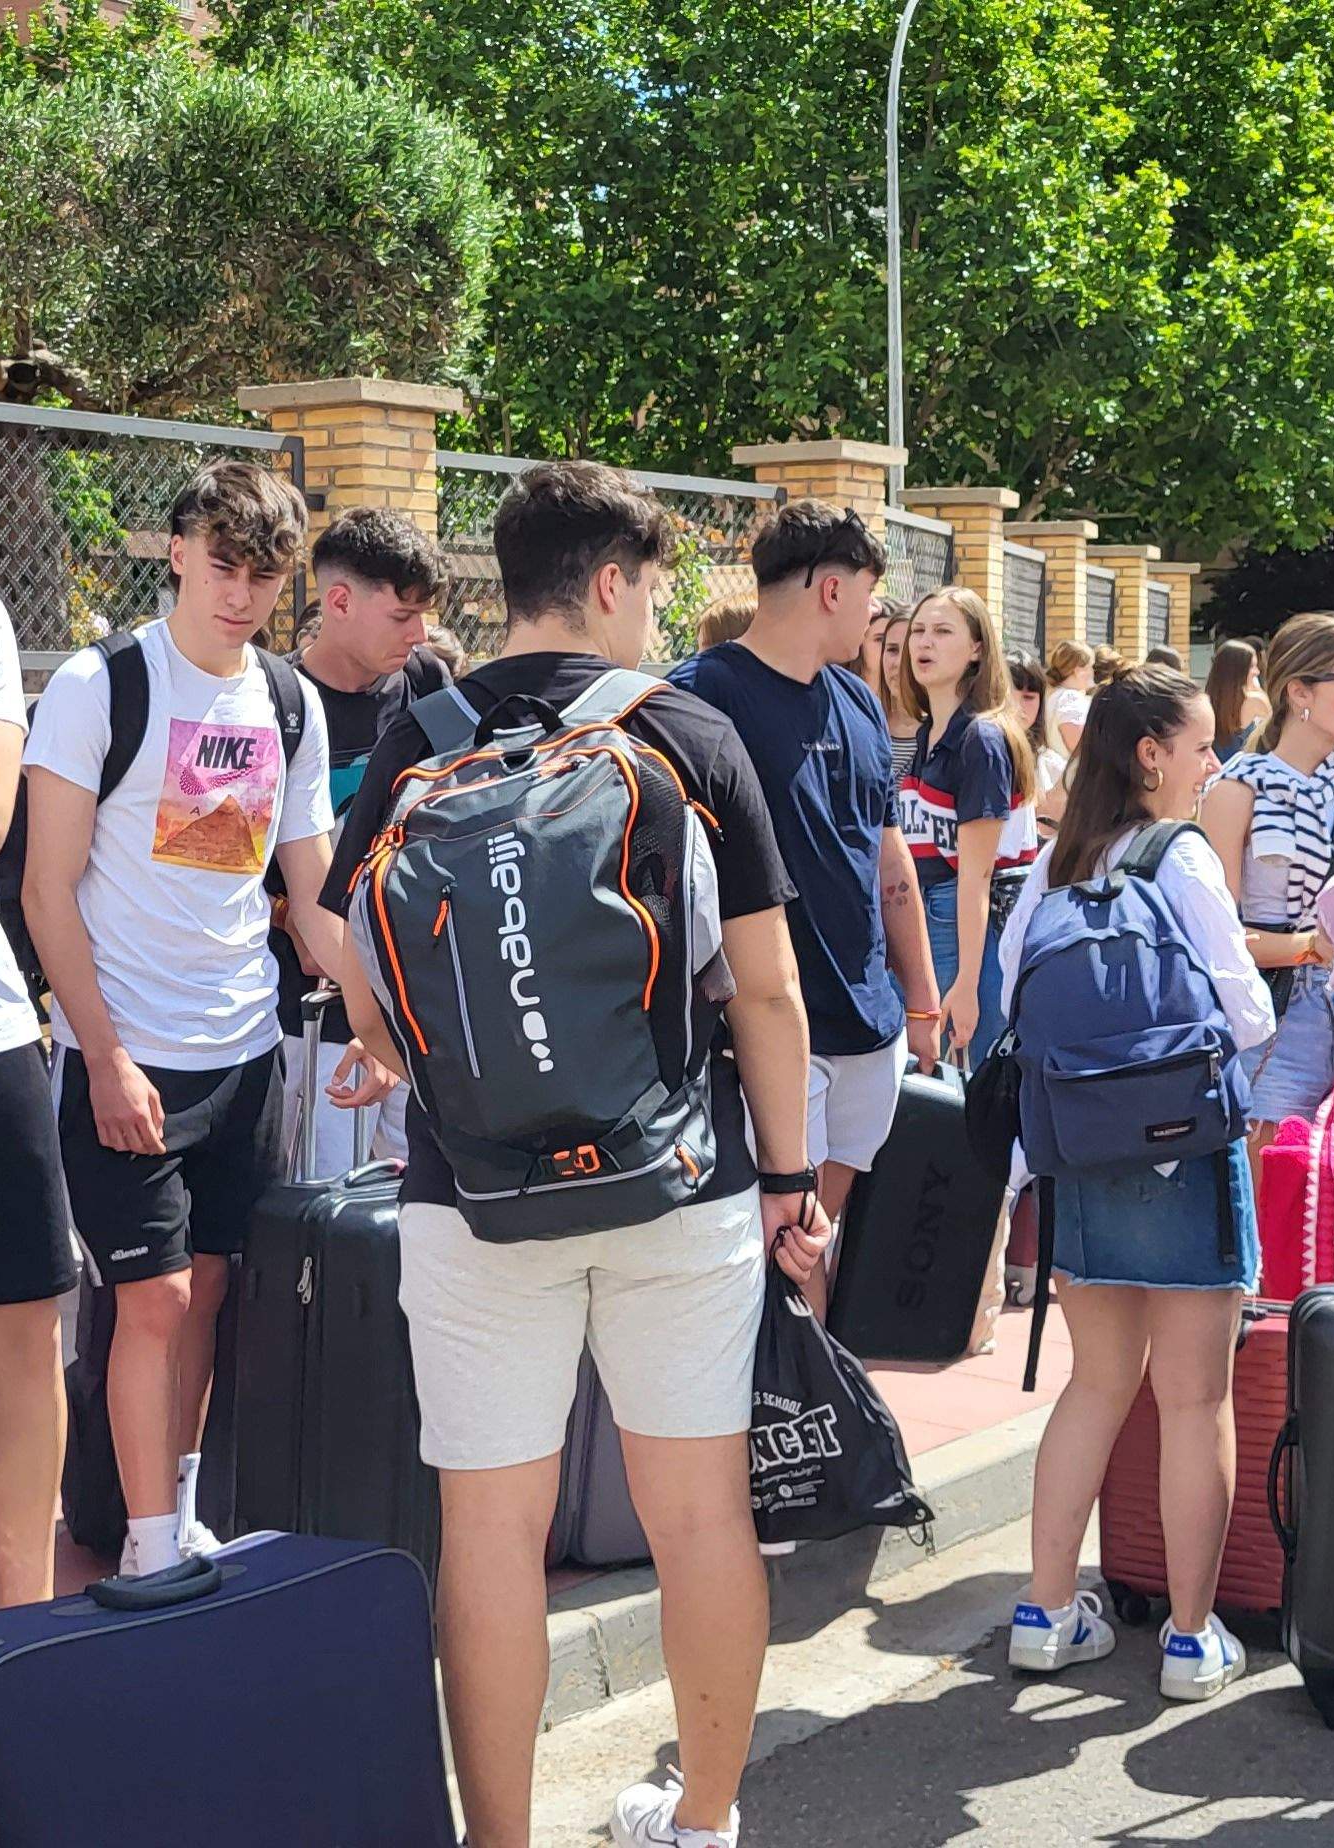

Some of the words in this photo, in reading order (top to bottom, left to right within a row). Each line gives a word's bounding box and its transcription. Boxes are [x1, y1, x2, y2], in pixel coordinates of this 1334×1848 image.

[195, 734, 257, 770] NIKE
[487, 831, 542, 1008] nabaiji
[895, 1161, 953, 1310] SONY
